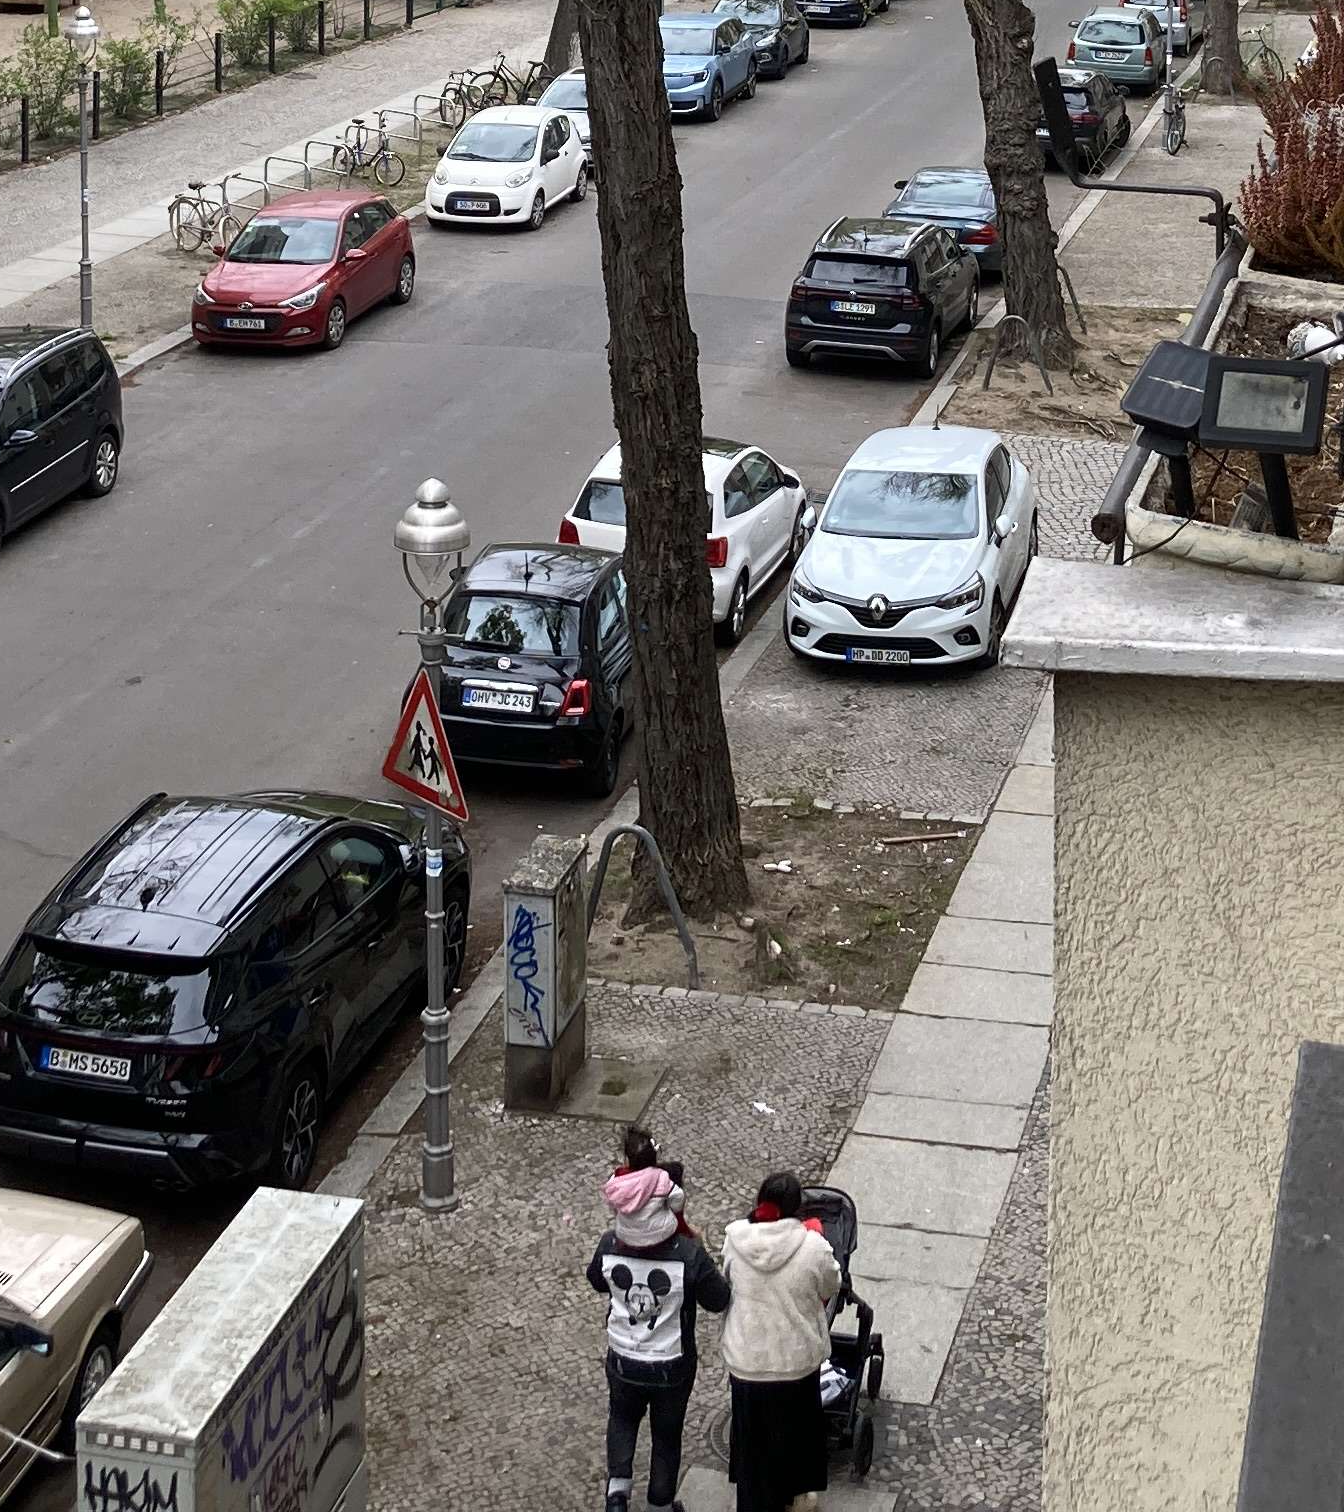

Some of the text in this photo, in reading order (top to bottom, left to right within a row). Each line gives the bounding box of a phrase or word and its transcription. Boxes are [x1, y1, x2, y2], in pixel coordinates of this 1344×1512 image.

[853, 649, 864, 659] HP
[471, 691, 532, 708] OHV JC 243
[50, 1050, 129, 1078] B MS 5658
